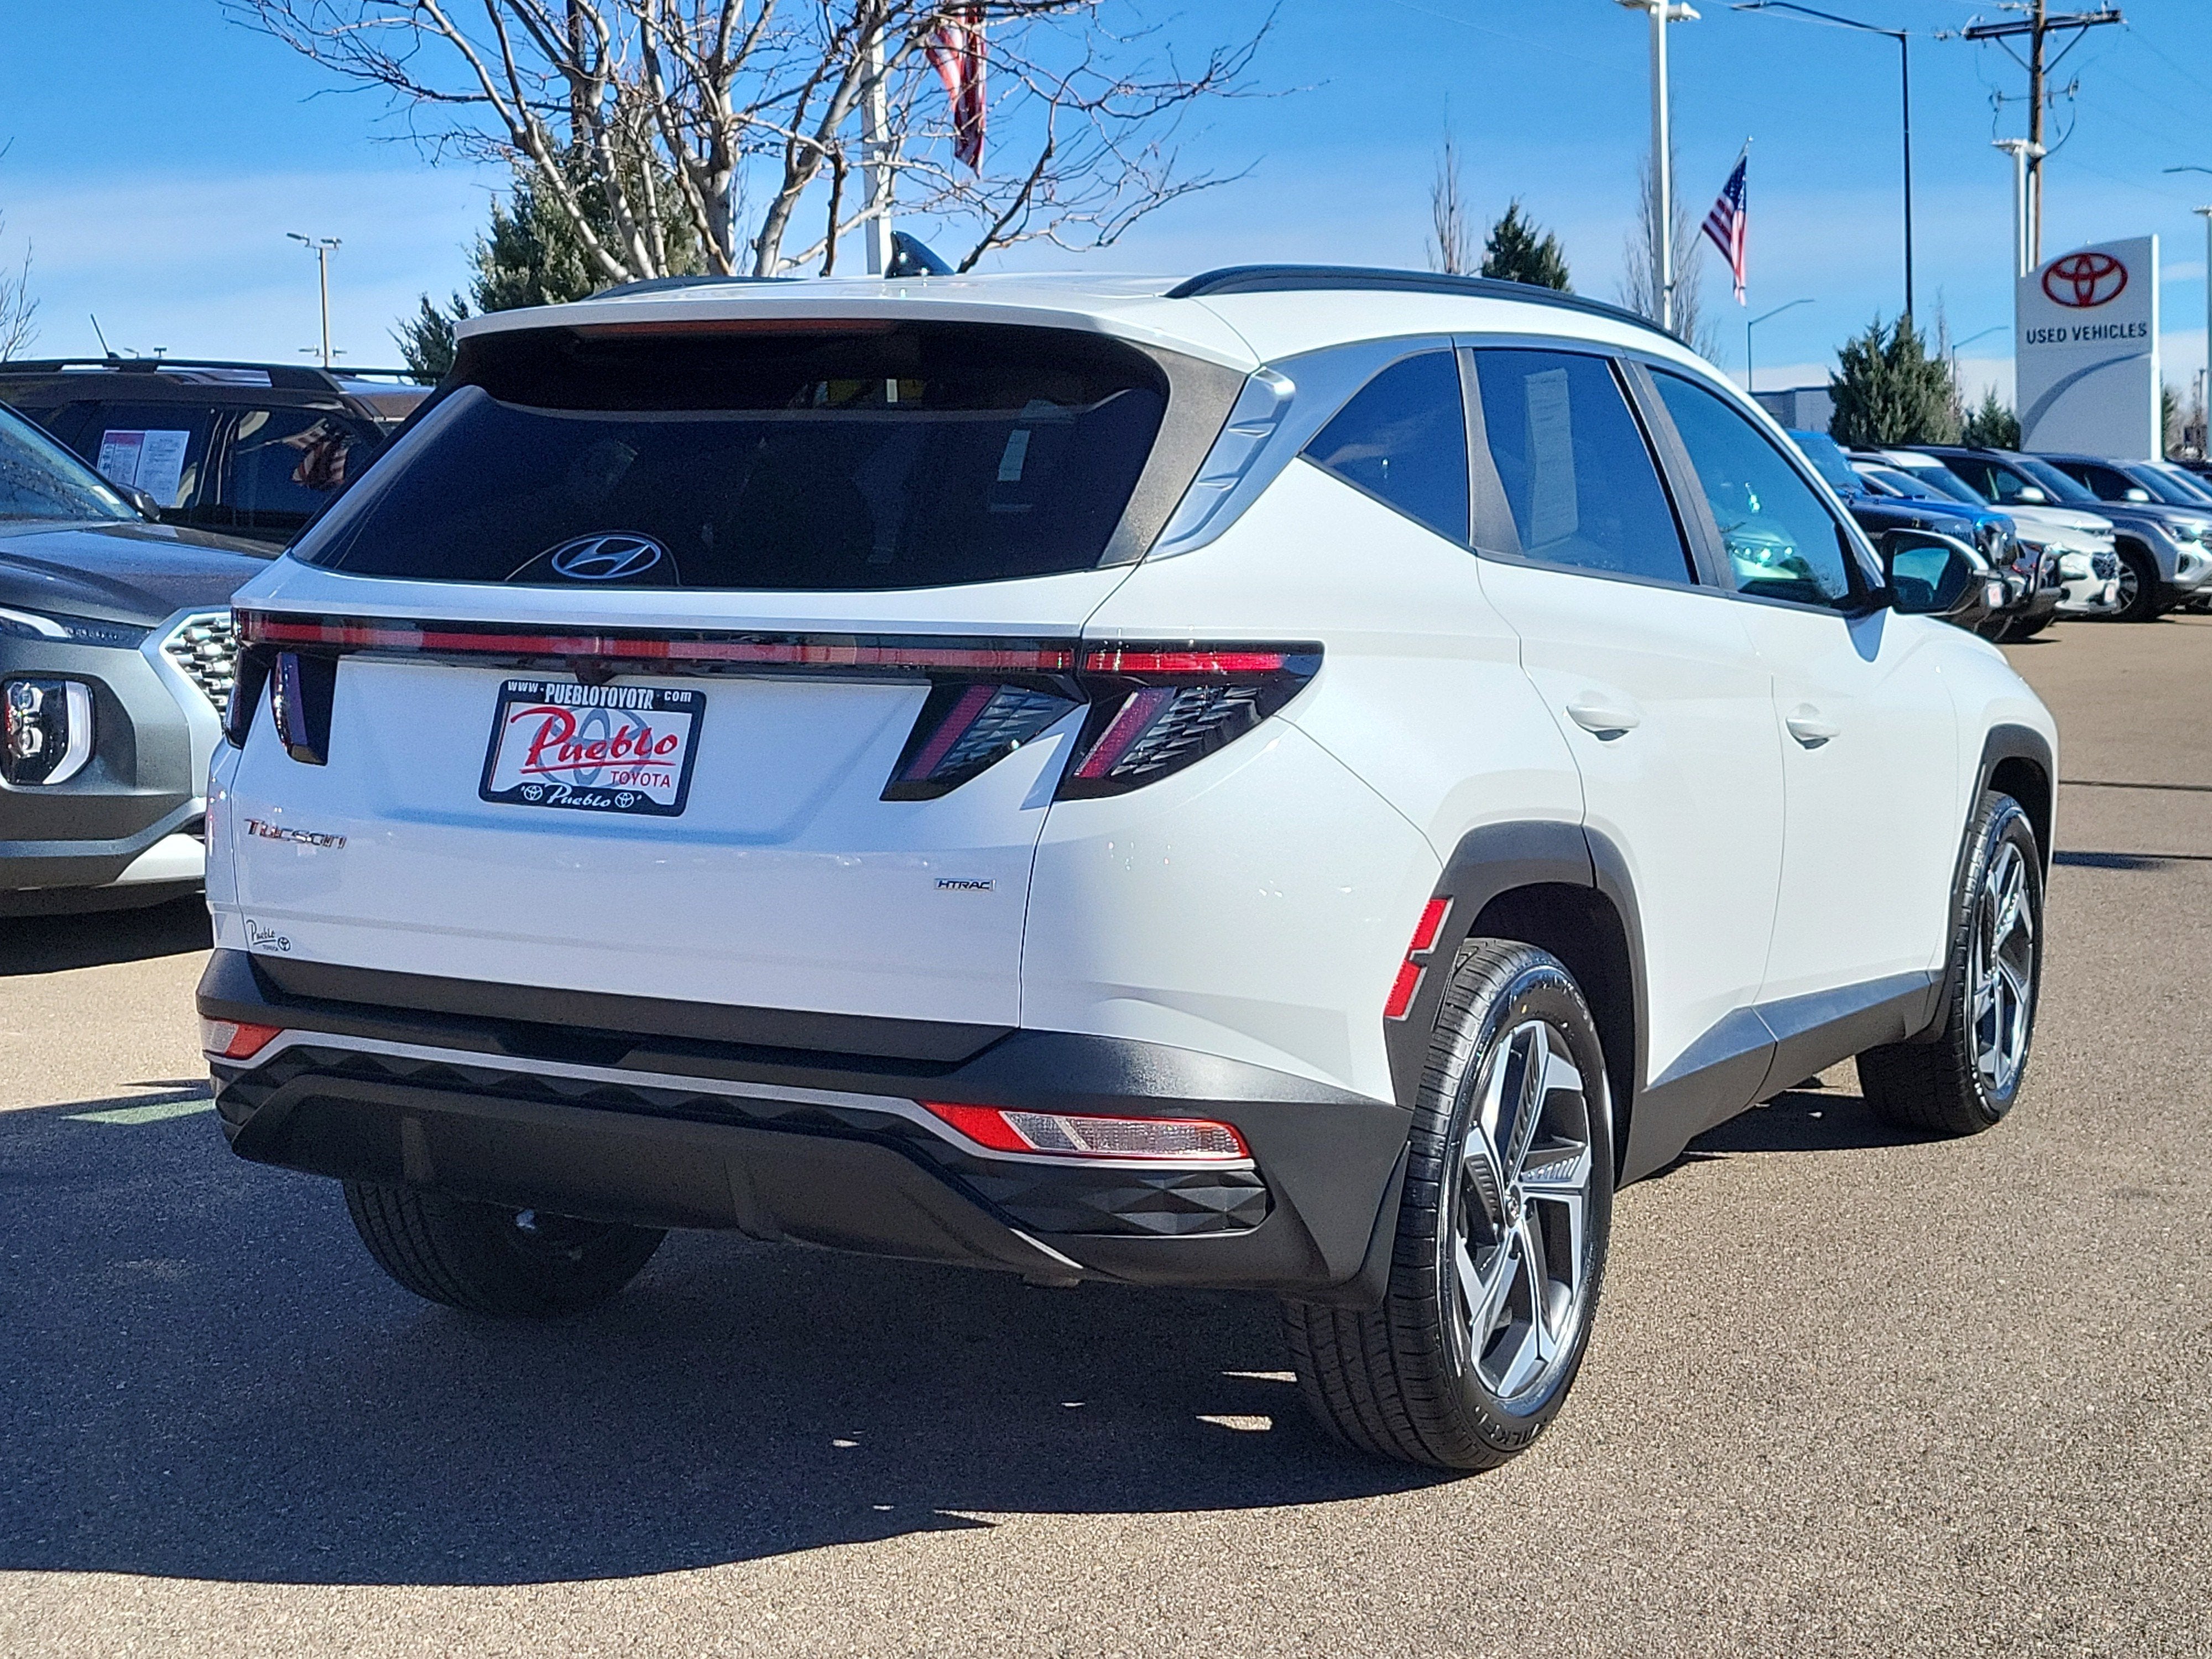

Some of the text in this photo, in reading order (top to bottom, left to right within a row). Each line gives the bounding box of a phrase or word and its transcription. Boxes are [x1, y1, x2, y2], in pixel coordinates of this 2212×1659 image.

[2026, 322, 2147, 344] USED VEHICLES
[510, 706, 678, 766] Pueblo
[611, 770, 670, 788] TOYOTA
[544, 783, 611, 807] Pueblo
[937, 880, 990, 890] HTRAC
